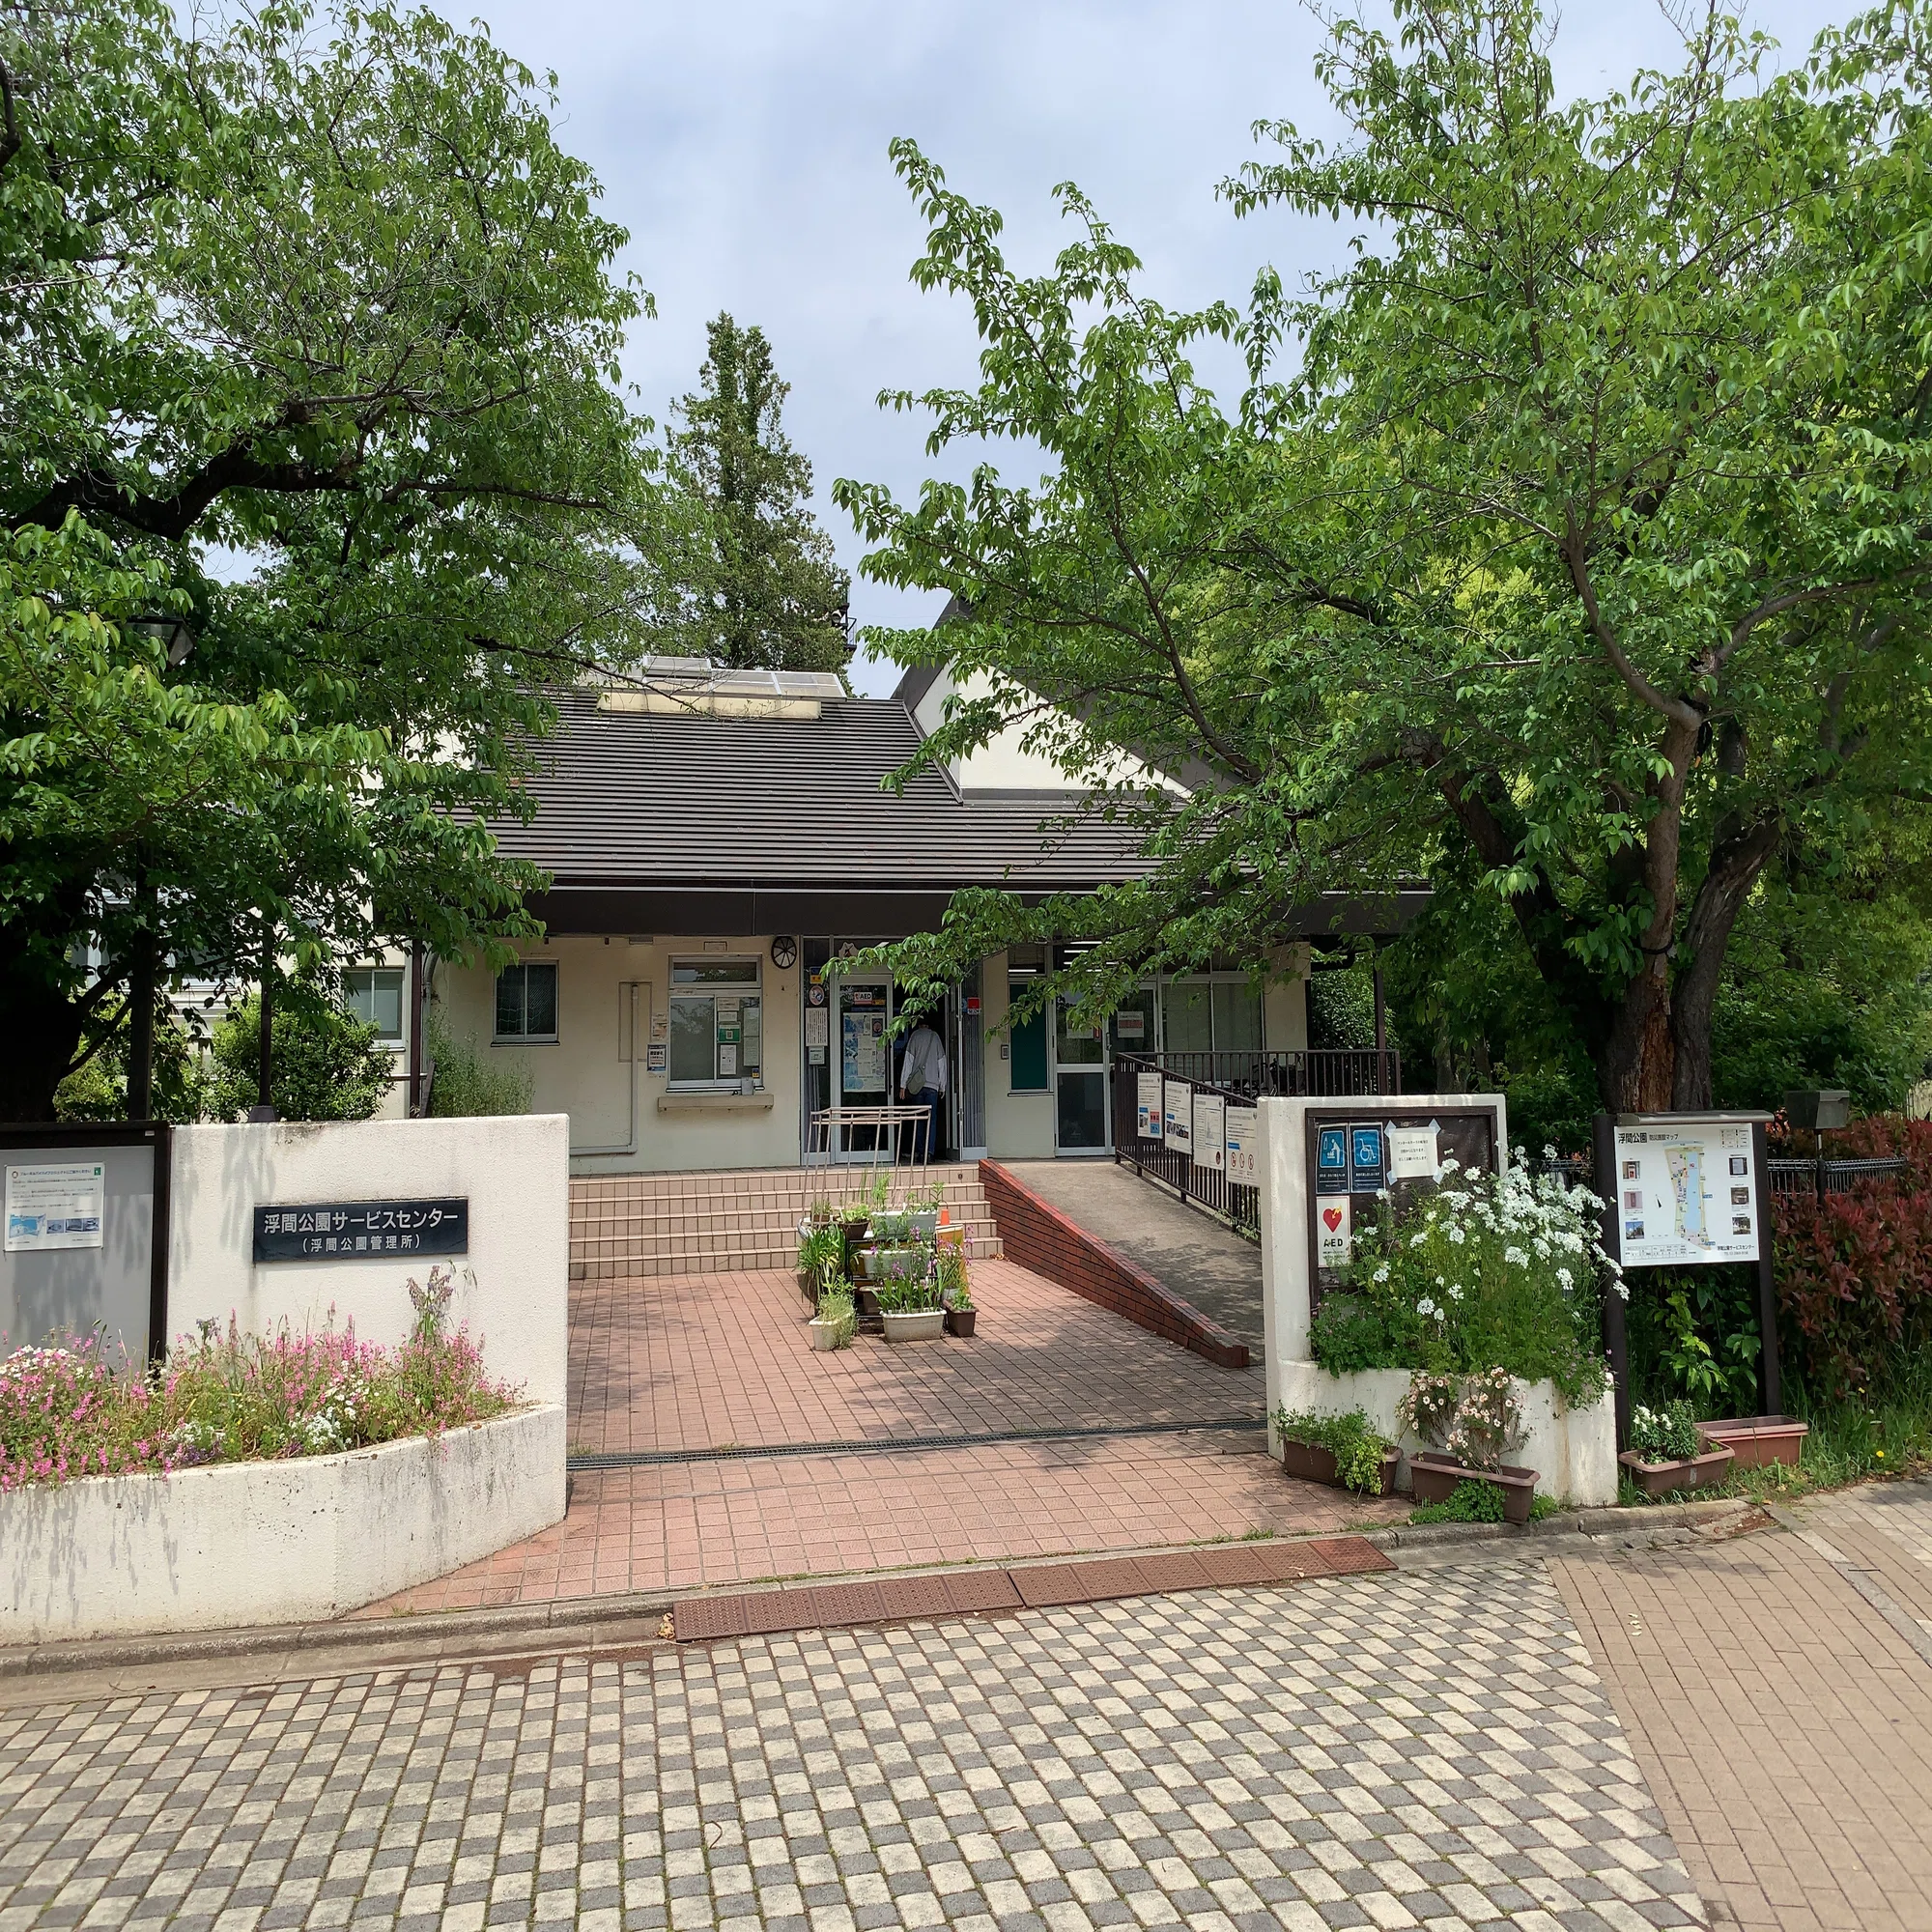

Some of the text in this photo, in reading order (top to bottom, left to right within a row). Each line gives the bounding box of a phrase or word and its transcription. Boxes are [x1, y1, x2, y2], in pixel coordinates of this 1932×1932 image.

[1618, 1132, 1648, 1144] 浮間公園
[264, 1208, 459, 1234] 浮間公園サービスセンター
[1323, 1238, 1343, 1247] AED
